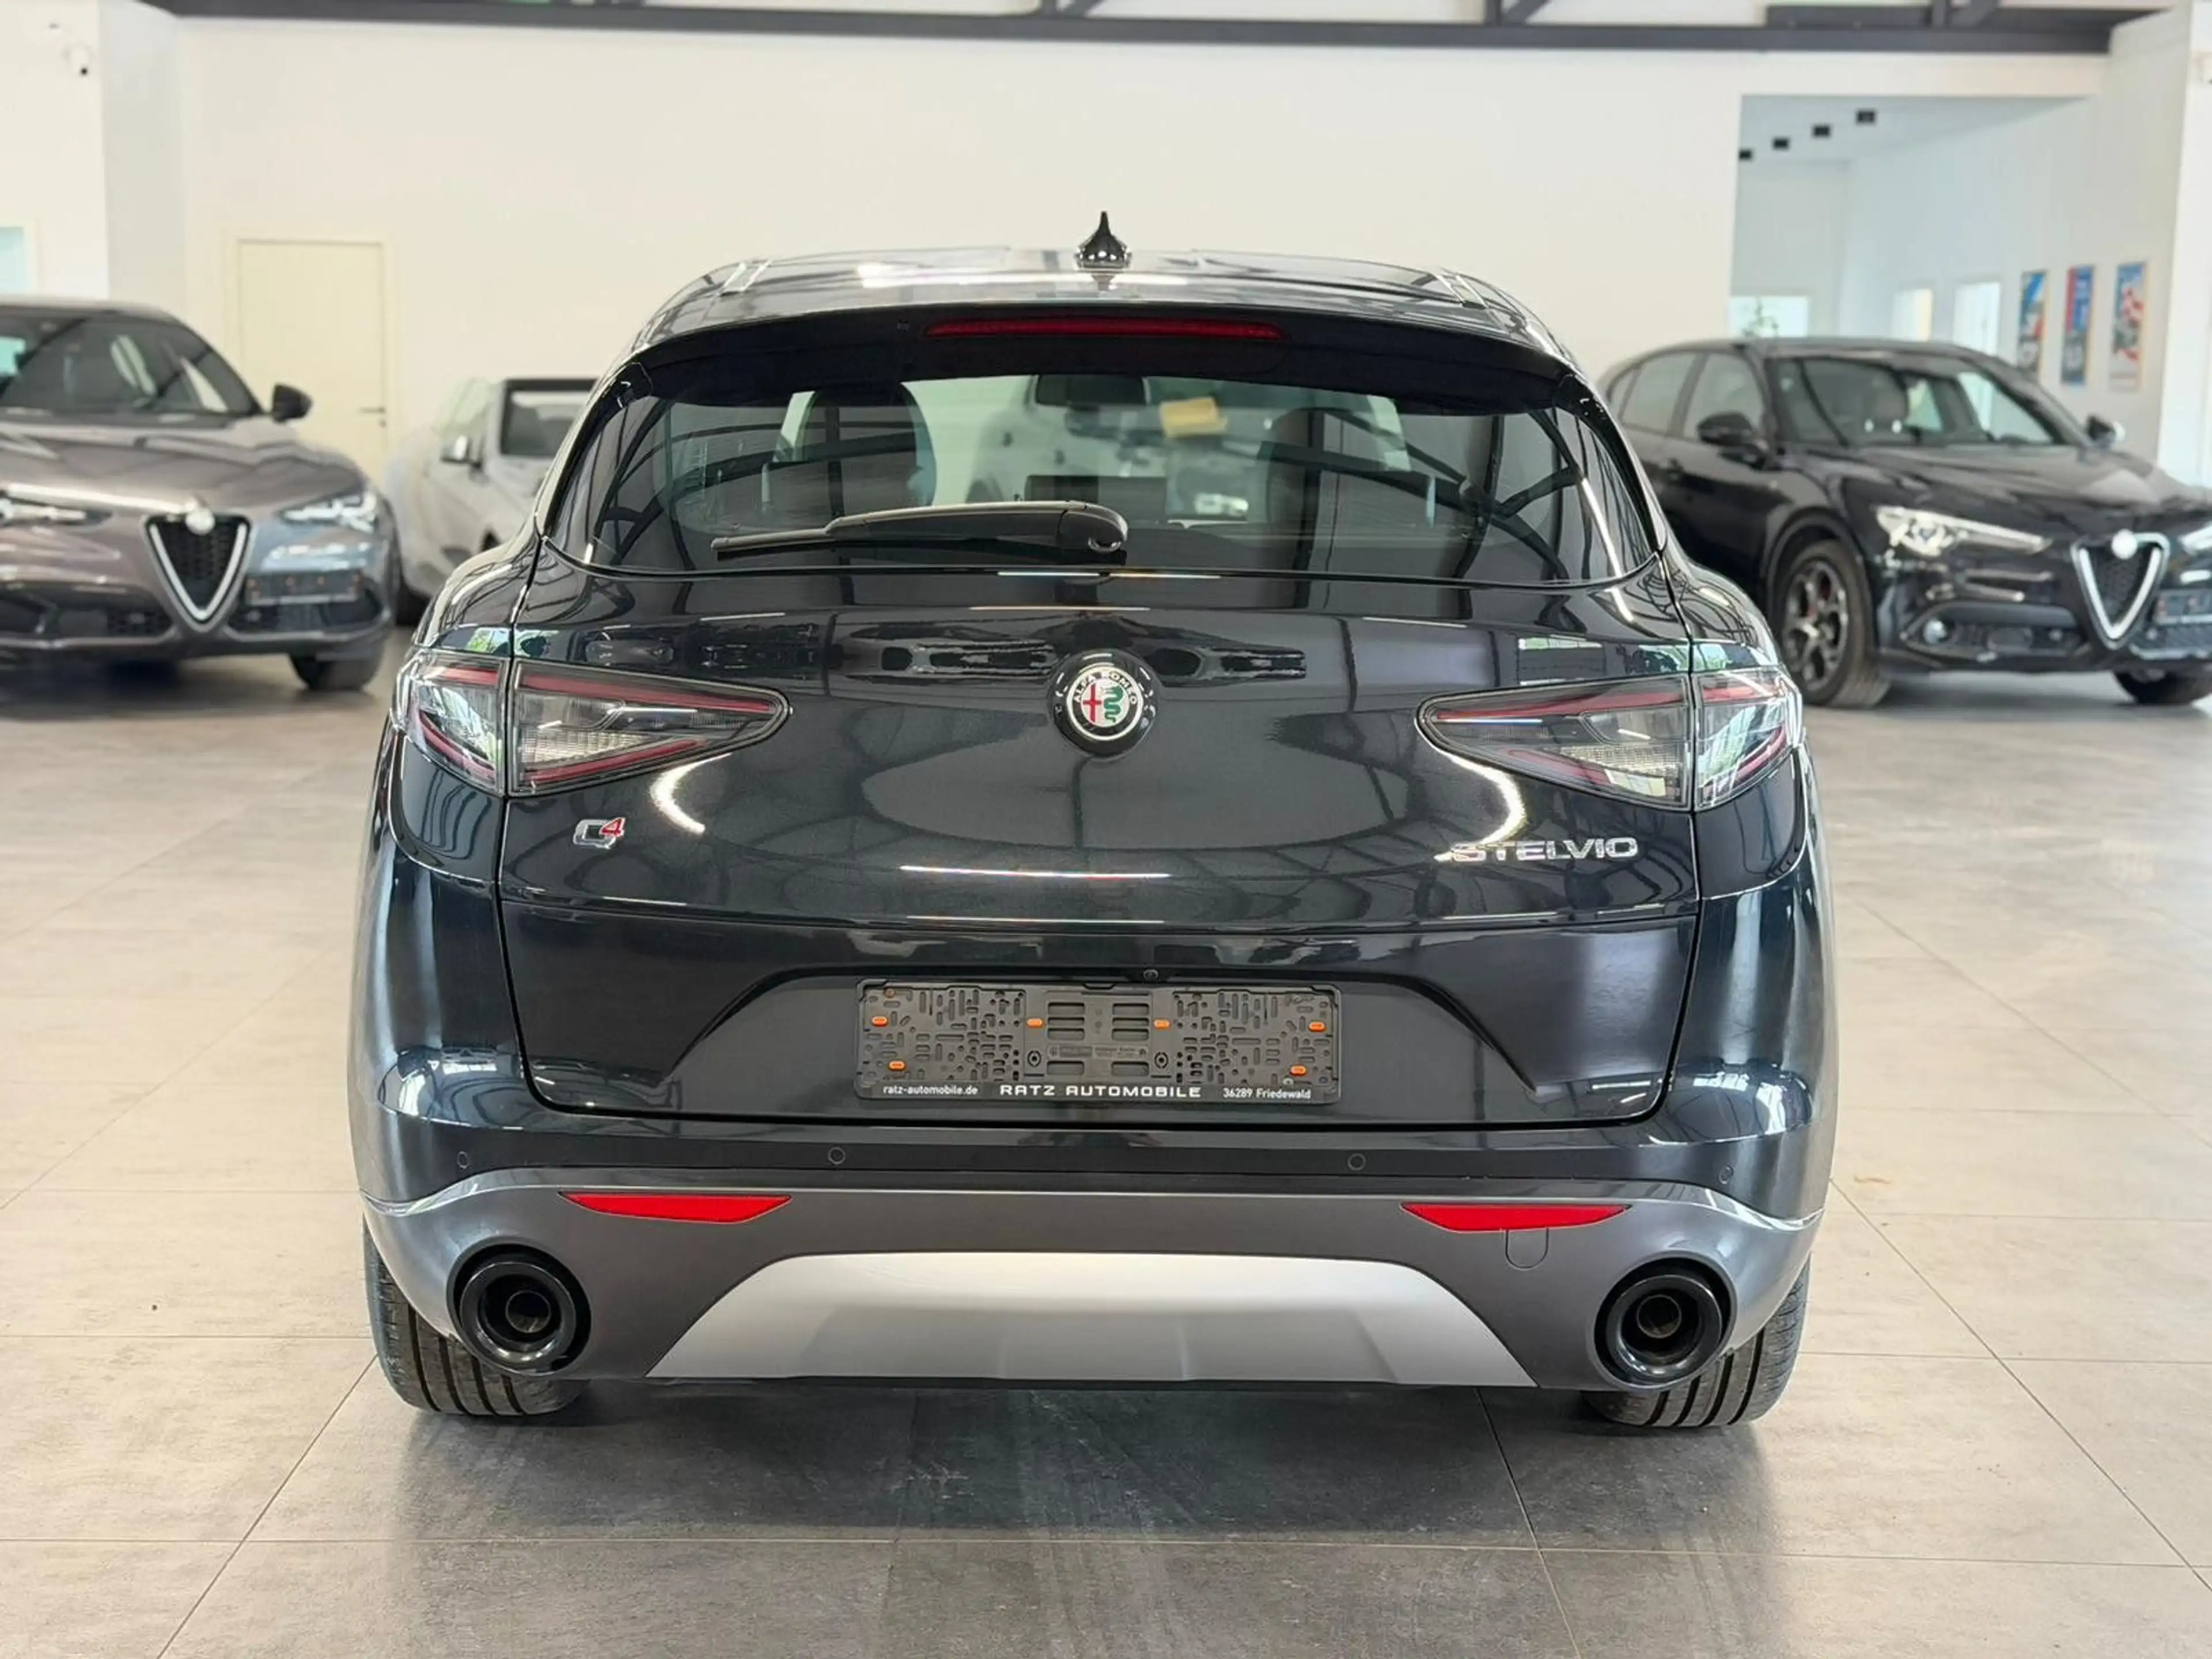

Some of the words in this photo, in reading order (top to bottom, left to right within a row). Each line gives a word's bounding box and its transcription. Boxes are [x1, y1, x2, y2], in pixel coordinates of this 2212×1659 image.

[1073, 675, 1095, 703] ALFA
[1450, 836, 1639, 862] STELVIO
[882, 1085, 979, 1095] ratz-automobile.de
[999, 1085, 1056, 1096] RATZ
[1066, 1085, 1202, 1097] AUTOMOBILE
[1222, 1088, 1253, 1099] 36289
[1256, 1088, 1312, 1100] Friedewald
